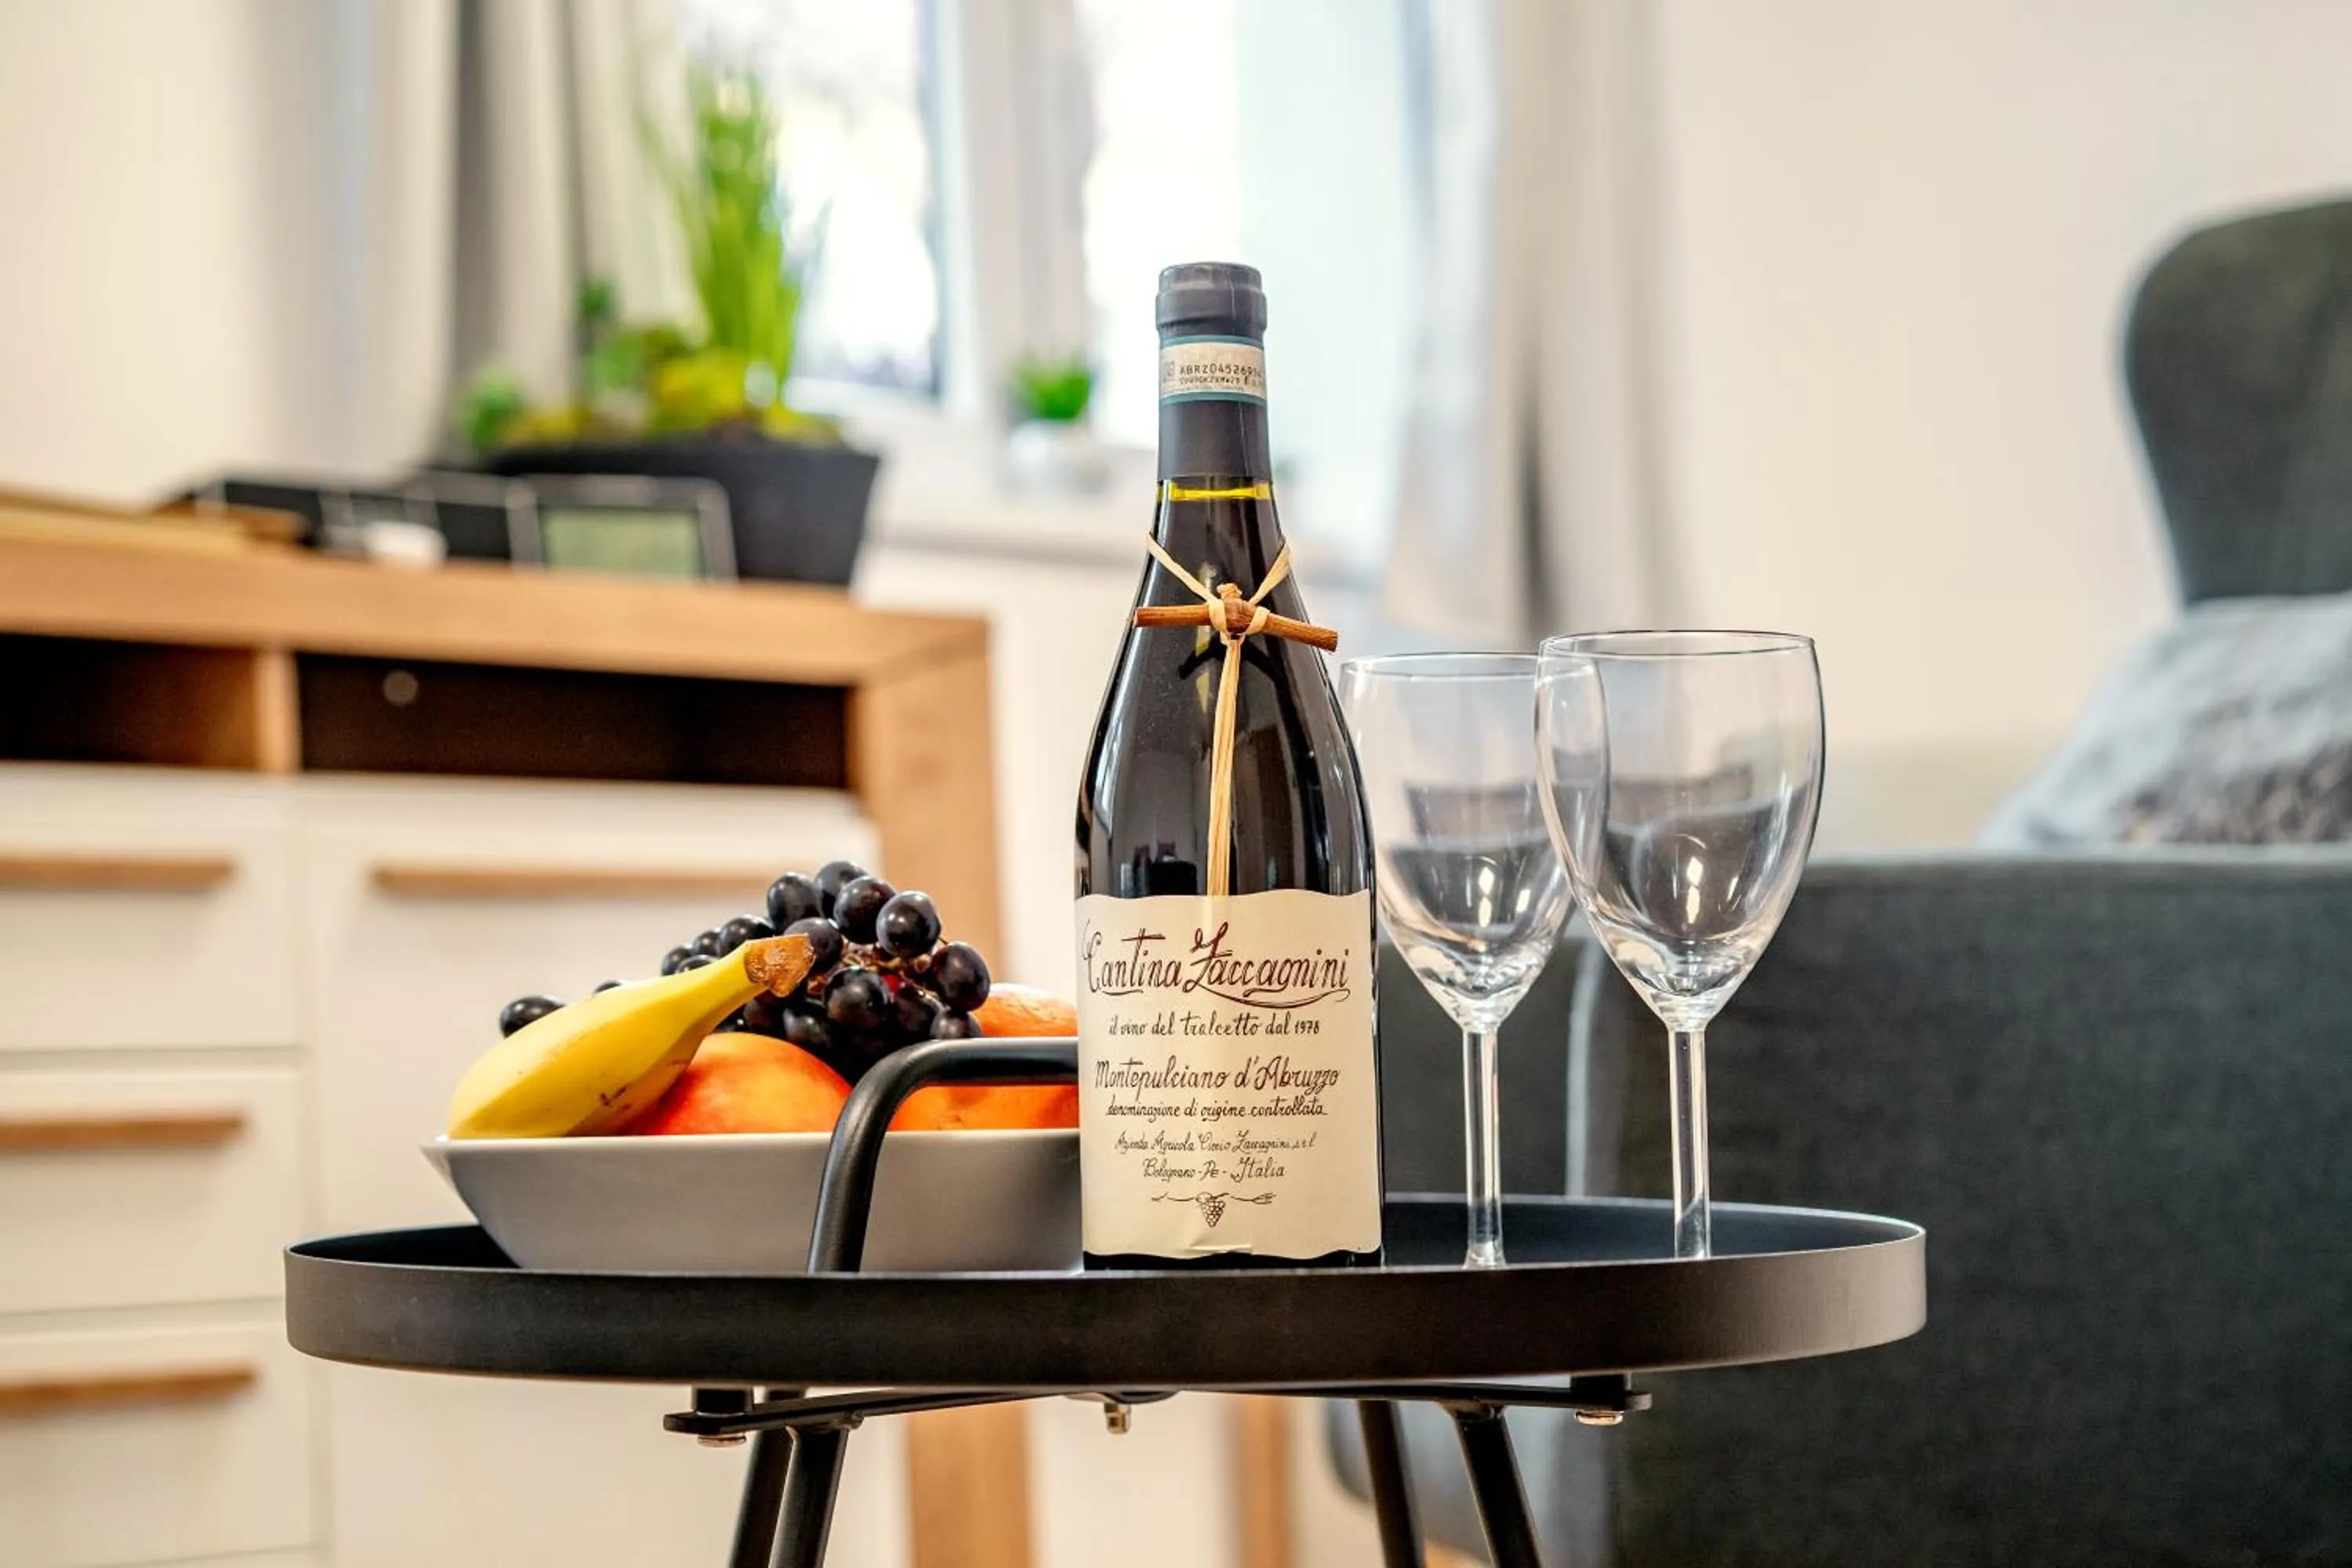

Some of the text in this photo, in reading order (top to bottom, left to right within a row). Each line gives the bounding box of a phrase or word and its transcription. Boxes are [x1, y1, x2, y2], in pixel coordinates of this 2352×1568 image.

[1083, 919, 1183, 996] Cantina
[1109, 1011, 1320, 1036] il vino del tralcetto dal 1978
[1094, 1054, 1341, 1101] Montepulciano d'Abruzzo
[1105, 1094, 1327, 1123] denominazione di origine controllata
[1230, 1156, 1286, 1184] Italia
